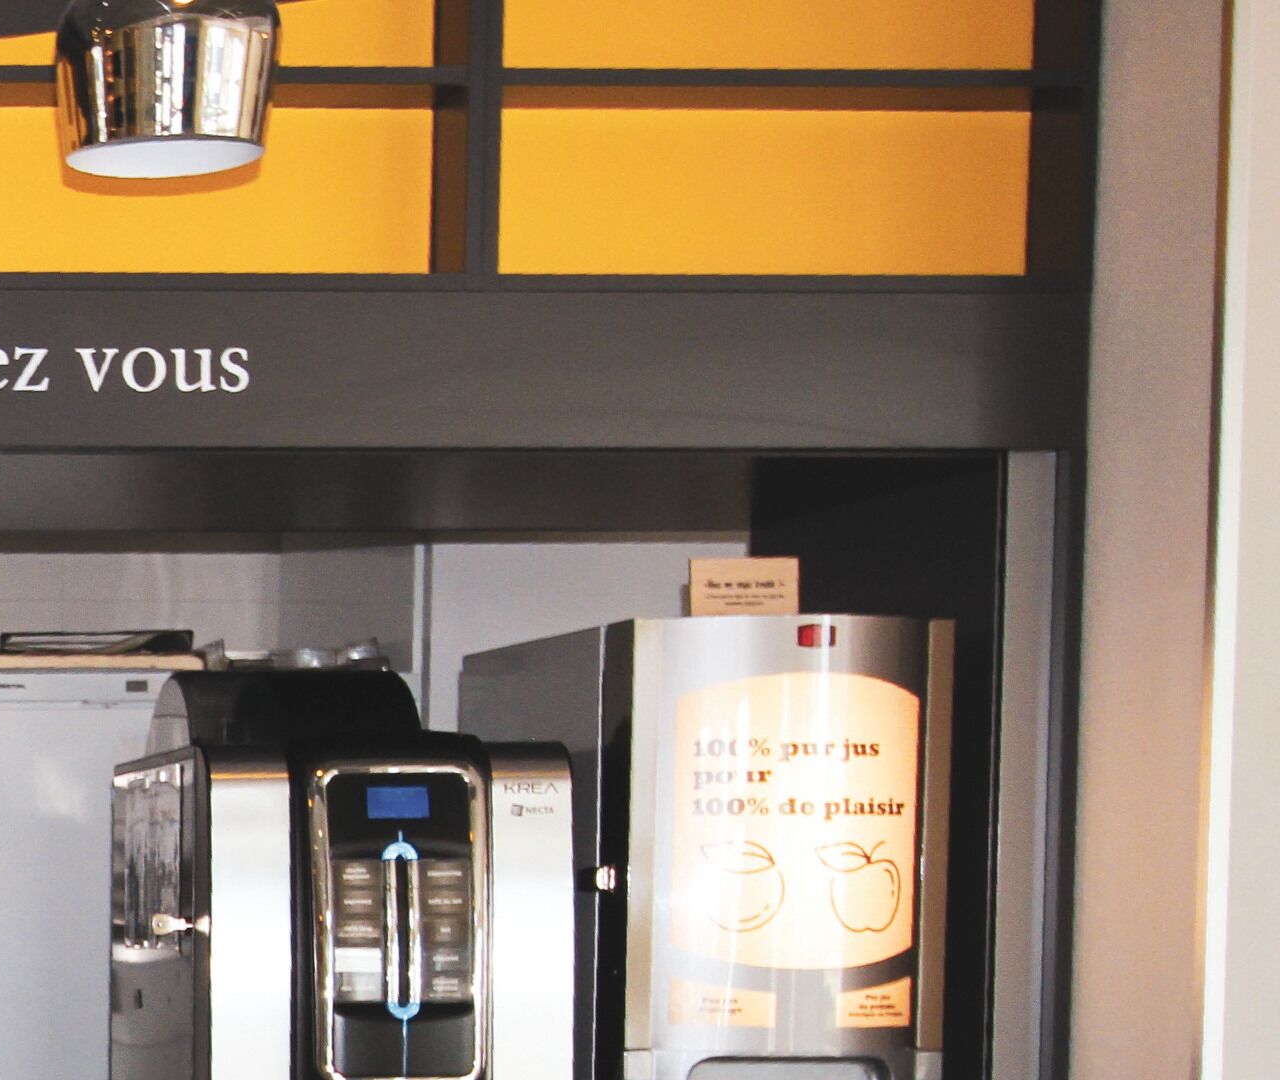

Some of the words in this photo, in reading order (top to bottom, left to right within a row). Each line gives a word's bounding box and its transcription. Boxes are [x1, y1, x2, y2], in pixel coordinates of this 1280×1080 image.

[74, 345, 251, 393] vous
[780, 742, 836, 761] pur
[842, 738, 880, 761] jus
[503, 781, 559, 795] KREA
[692, 797, 770, 816] 100%
[778, 797, 815, 815] de
[823, 796, 905, 820] plaisir
